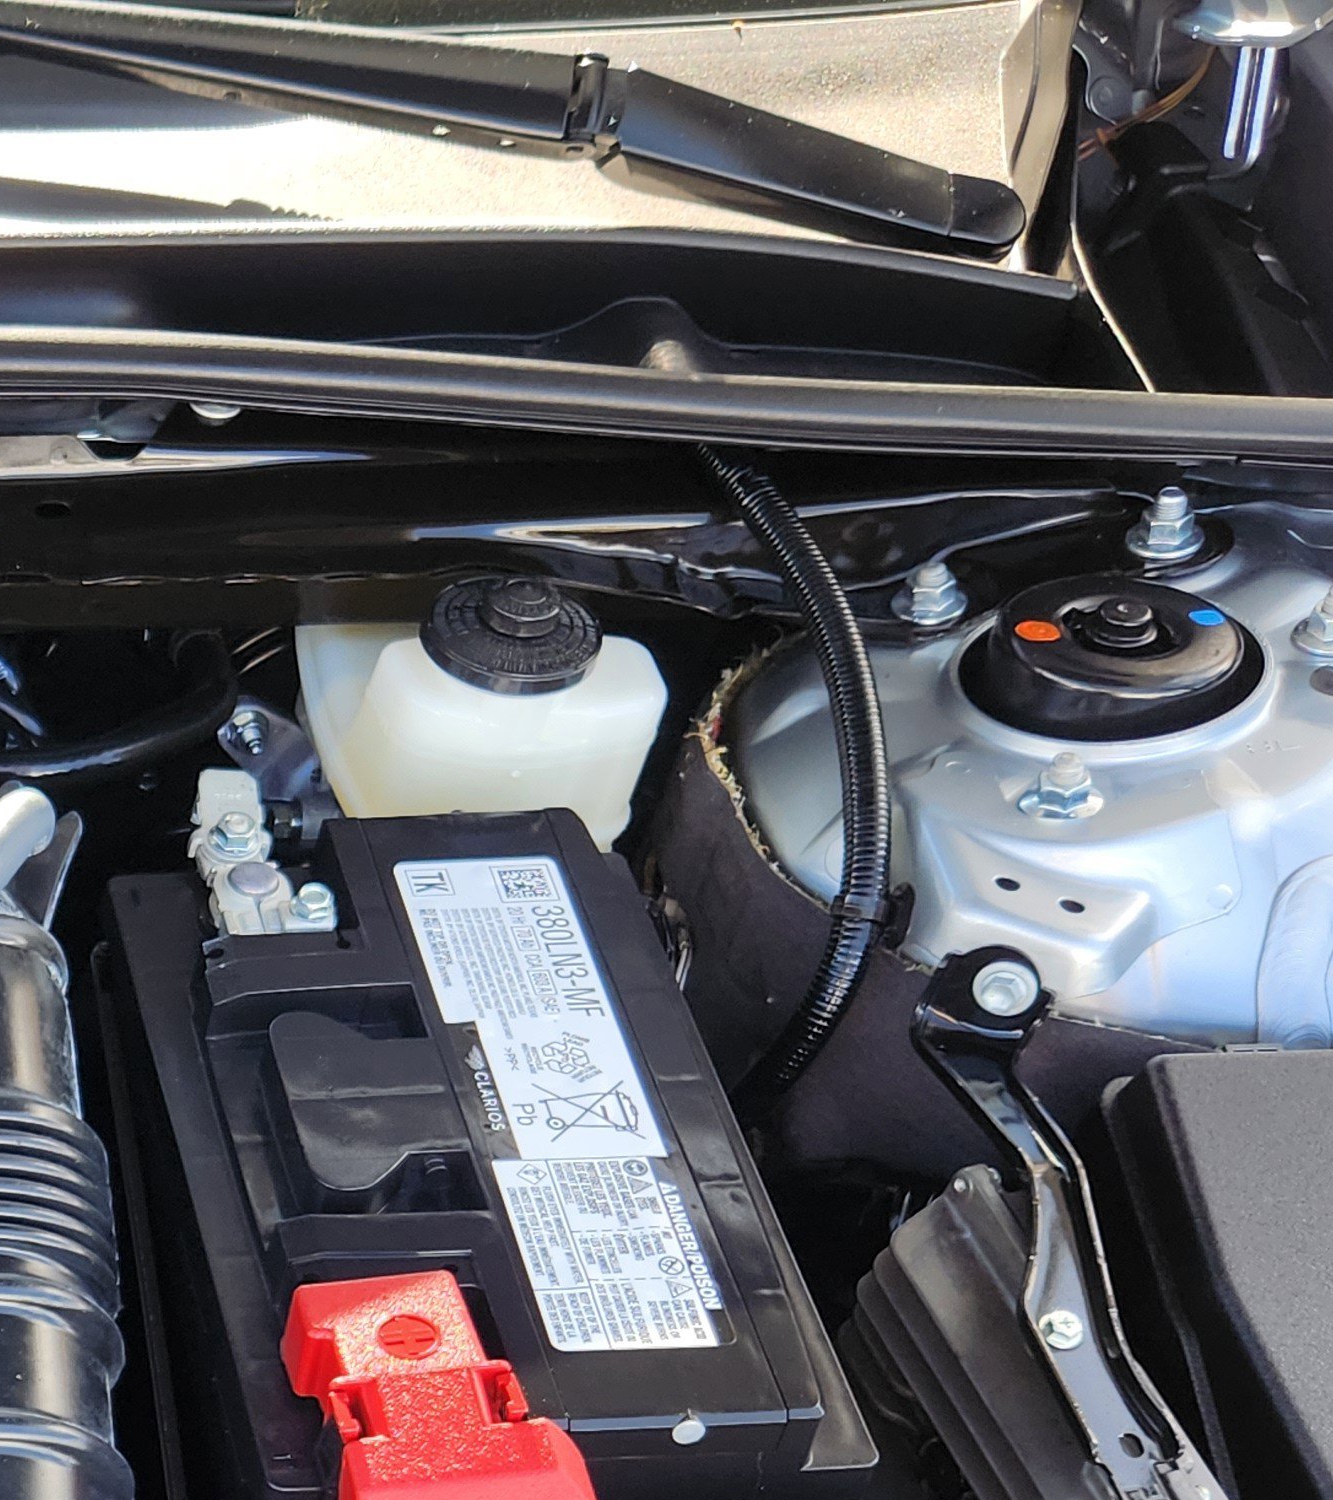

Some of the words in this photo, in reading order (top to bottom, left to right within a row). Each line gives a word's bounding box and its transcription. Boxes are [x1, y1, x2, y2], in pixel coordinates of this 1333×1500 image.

[409, 872, 449, 893] TK
[530, 905, 605, 1017] 380LN3-MF
[470, 1070, 507, 1131] CLARIOS
[510, 1102, 540, 1126] Pb
[663, 1190, 722, 1311] DANGER/POISON
